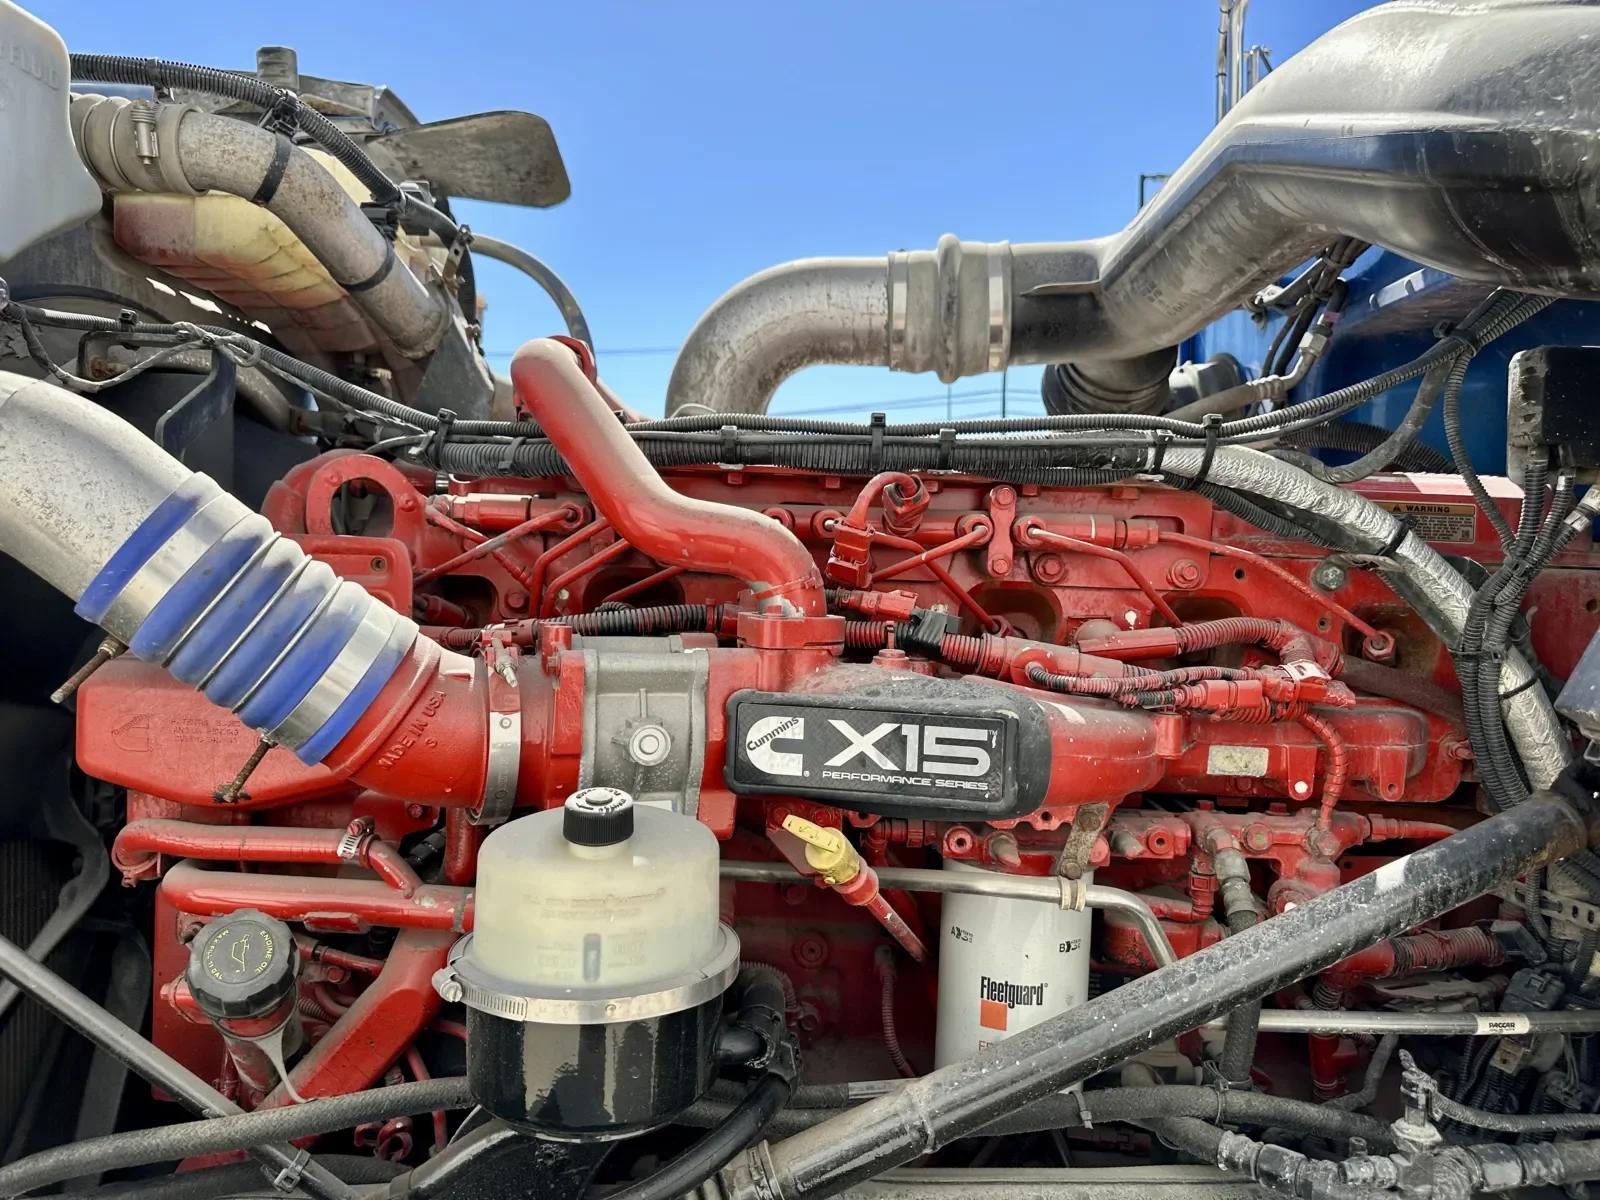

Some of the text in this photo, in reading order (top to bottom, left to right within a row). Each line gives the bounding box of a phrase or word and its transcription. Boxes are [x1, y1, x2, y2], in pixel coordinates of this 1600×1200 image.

[1406, 504, 1450, 513] WARNING
[377, 690, 447, 770] MADE IN USA
[746, 716, 800, 752] Cummins
[823, 719, 991, 777] X15
[822, 770, 989, 791] PERFORMANCE SERIES
[213, 929, 229, 944] MAX
[254, 930, 274, 973] ENGINE OIL
[980, 975, 1044, 1009] Fleetguard
